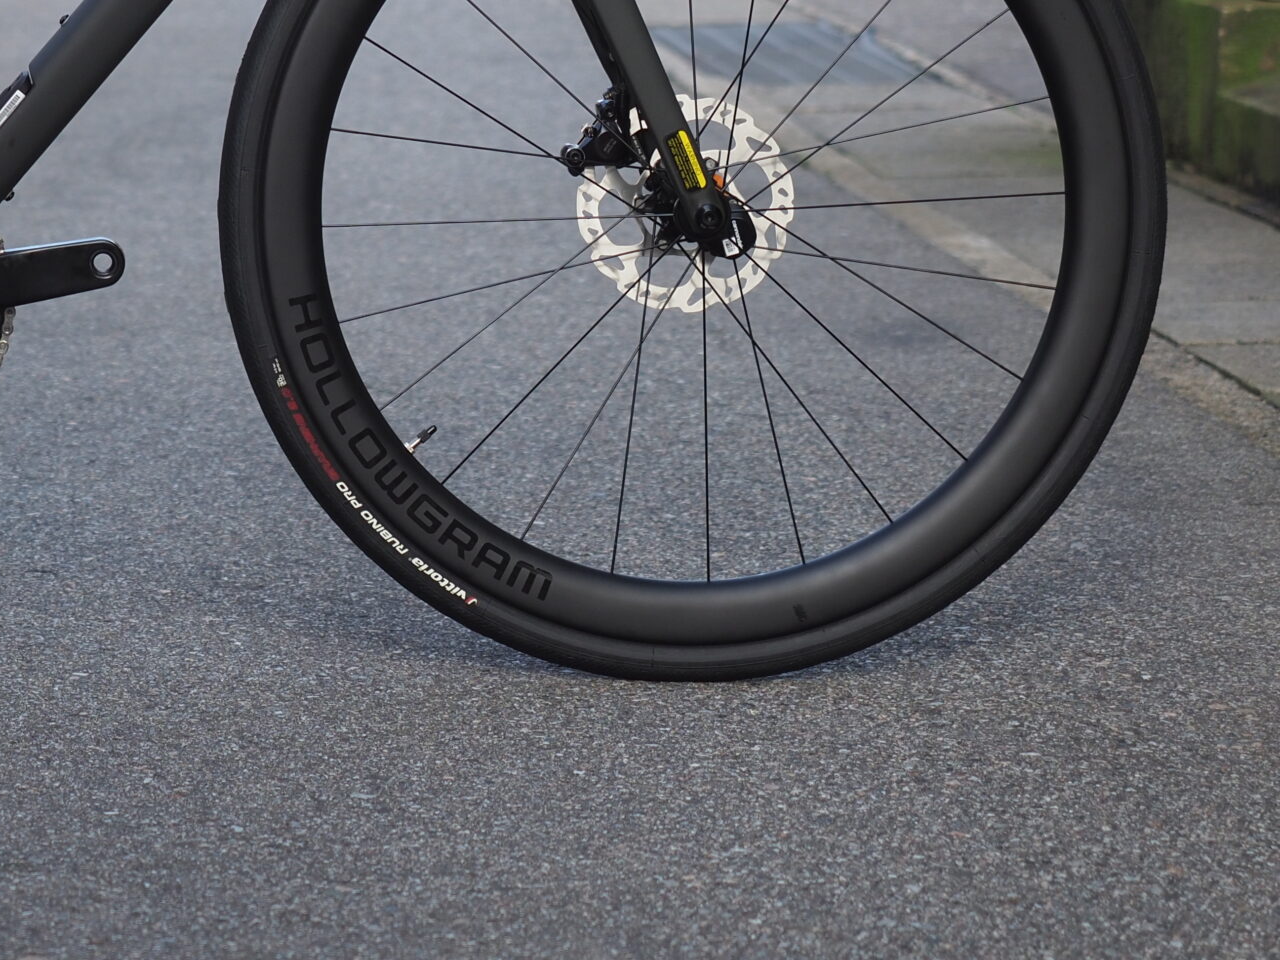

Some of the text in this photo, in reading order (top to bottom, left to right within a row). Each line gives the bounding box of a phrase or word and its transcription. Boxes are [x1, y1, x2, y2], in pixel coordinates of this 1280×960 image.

[288, 293, 554, 602] HOLLOWGRAM
[336, 481, 363, 510] PRO
[360, 509, 409, 555] RUBINO
